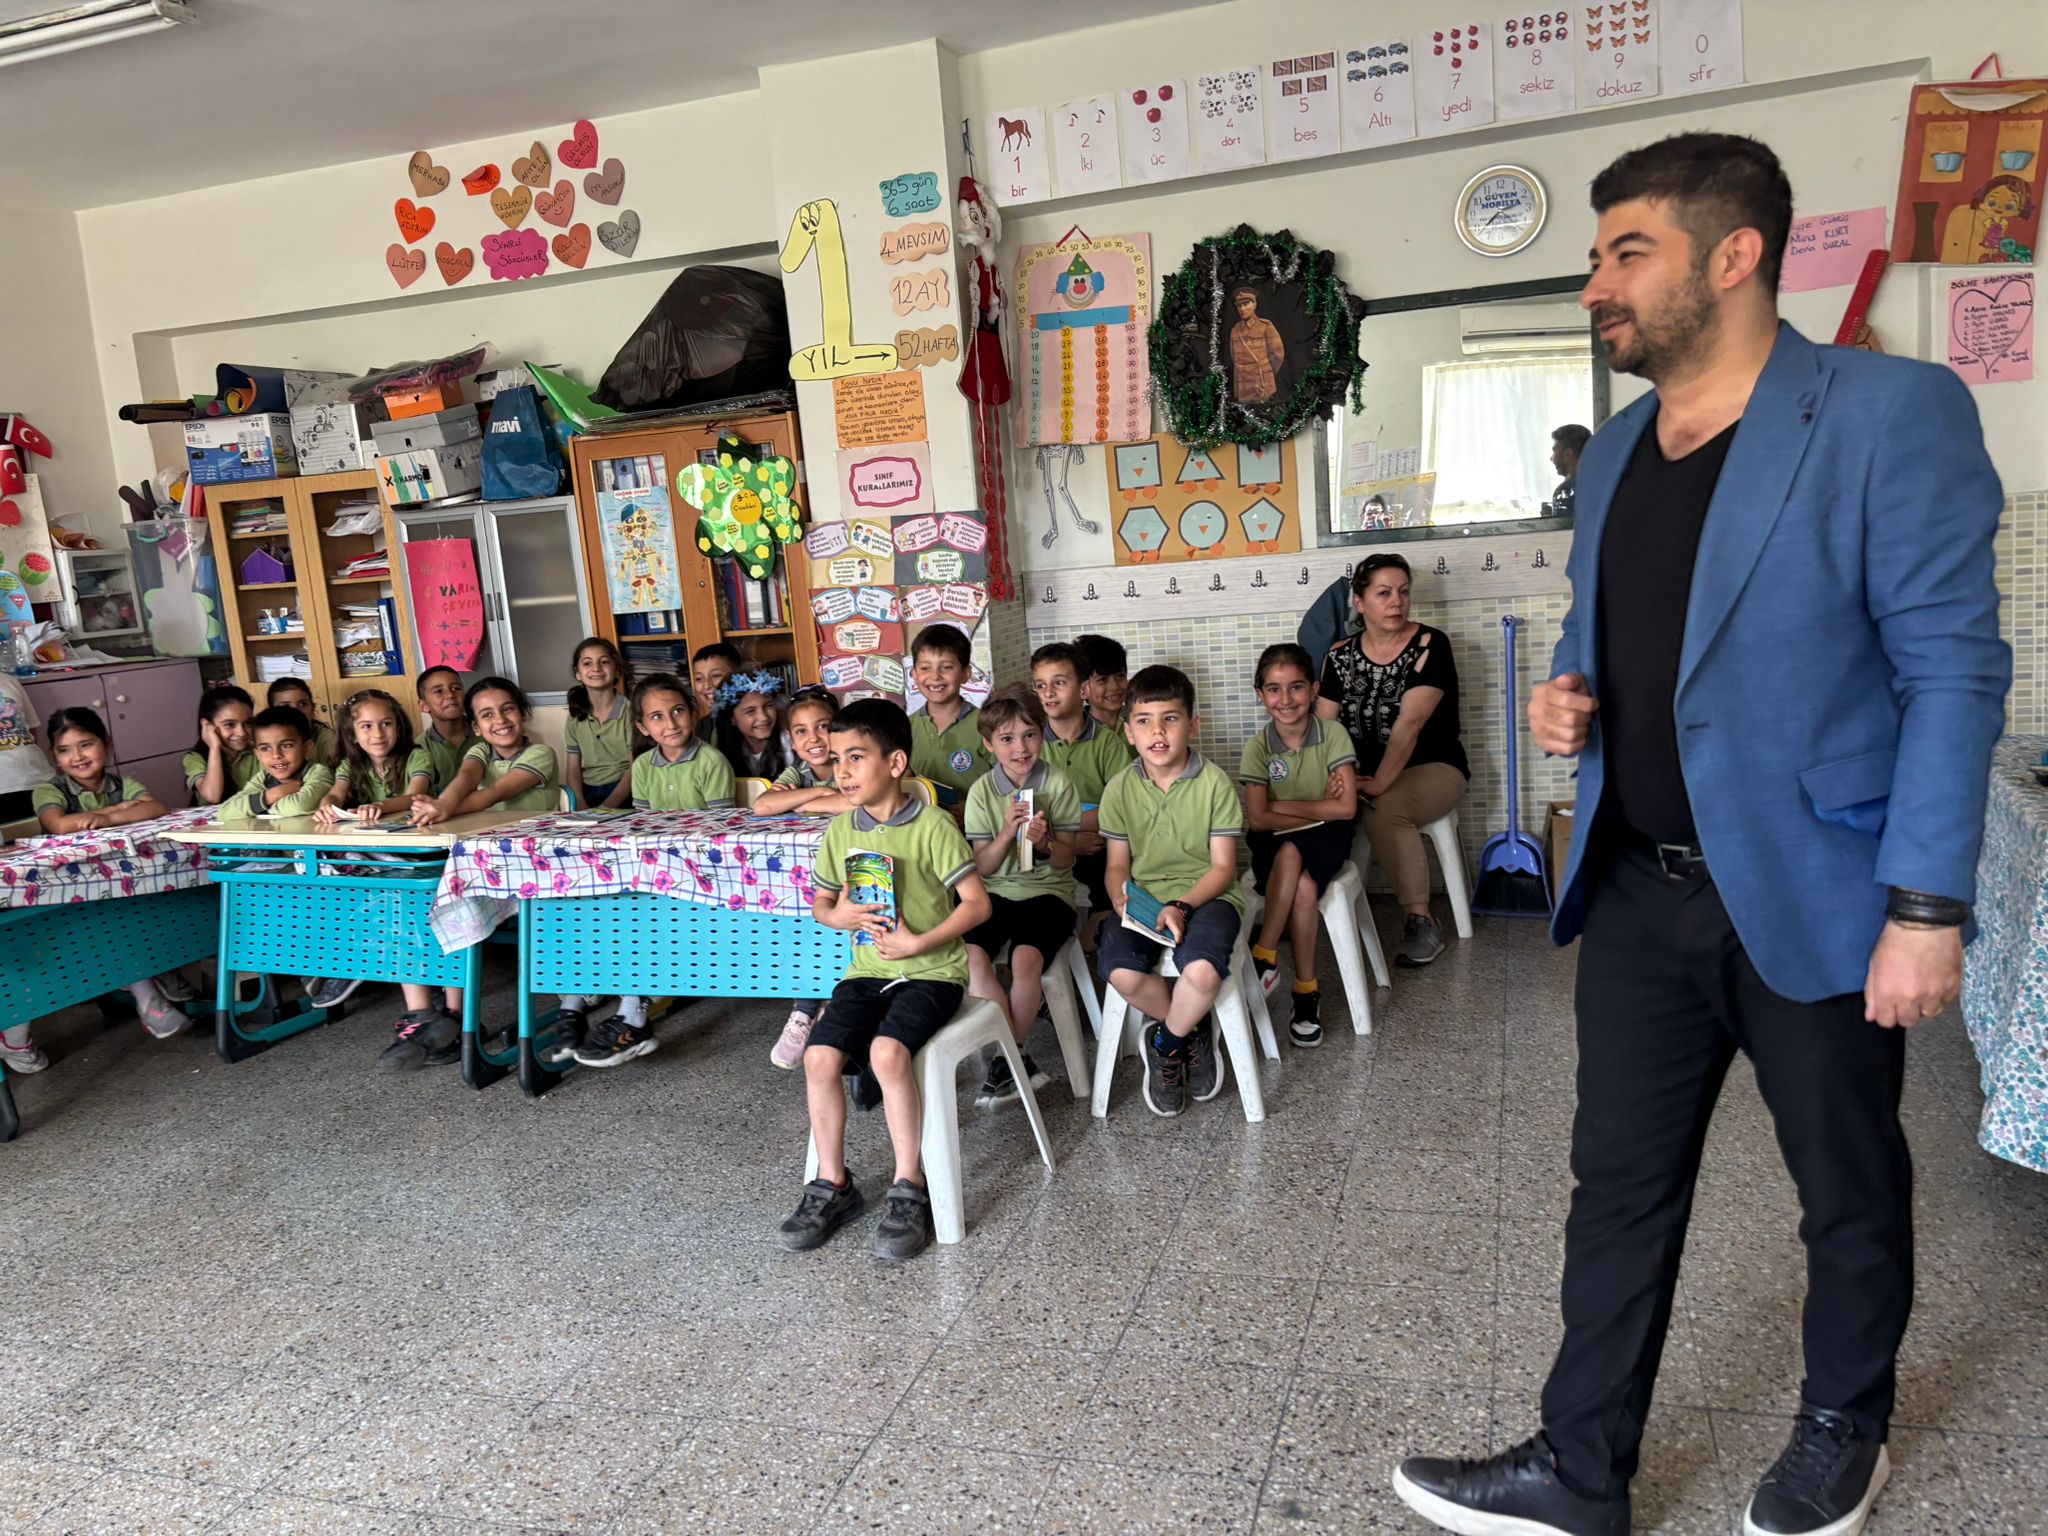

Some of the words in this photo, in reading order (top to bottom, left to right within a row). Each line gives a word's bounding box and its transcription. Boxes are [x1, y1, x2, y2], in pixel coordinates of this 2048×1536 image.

[1696, 34, 1708, 53] 0
[1531, 49, 1542, 65] 8
[1614, 53, 1624, 69] 9
[1451, 73, 1461, 90] 7
[1519, 76, 1554, 94] sekiz
[1596, 80, 1642, 98] dokuz
[1374, 86, 1383, 102] 6
[1299, 98, 1309, 113] 5
[1442, 96, 1472, 122] yedi
[1226, 118, 1234, 128] 4
[1080, 132, 1090, 148] 2
[1152, 128, 1161, 142] 3
[1014, 156, 1020, 174] 1
[412, 163, 446, 187] MERHABA
[881, 178, 908, 199] 365
[912, 177, 933, 196] gün
[1011, 184, 1028, 197] bir
[888, 198, 900, 216] 6
[904, 196, 934, 211] saat
[880, 237, 896, 257] 4
[896, 228, 946, 252] MEVSİM
[892, 280, 913, 304] 12
[916, 278, 940, 301] AY
[898, 334, 922, 360] 52
[923, 337, 957, 352] HAFTA
[803, 346, 850, 373] YIL
[185, 423, 206, 431] EPSON
[272, 416, 290, 424] EPSO
[492, 416, 522, 434] mavi
[874, 472, 894, 480] SINIF
[858, 480, 914, 492] KURALLARIMIZ
